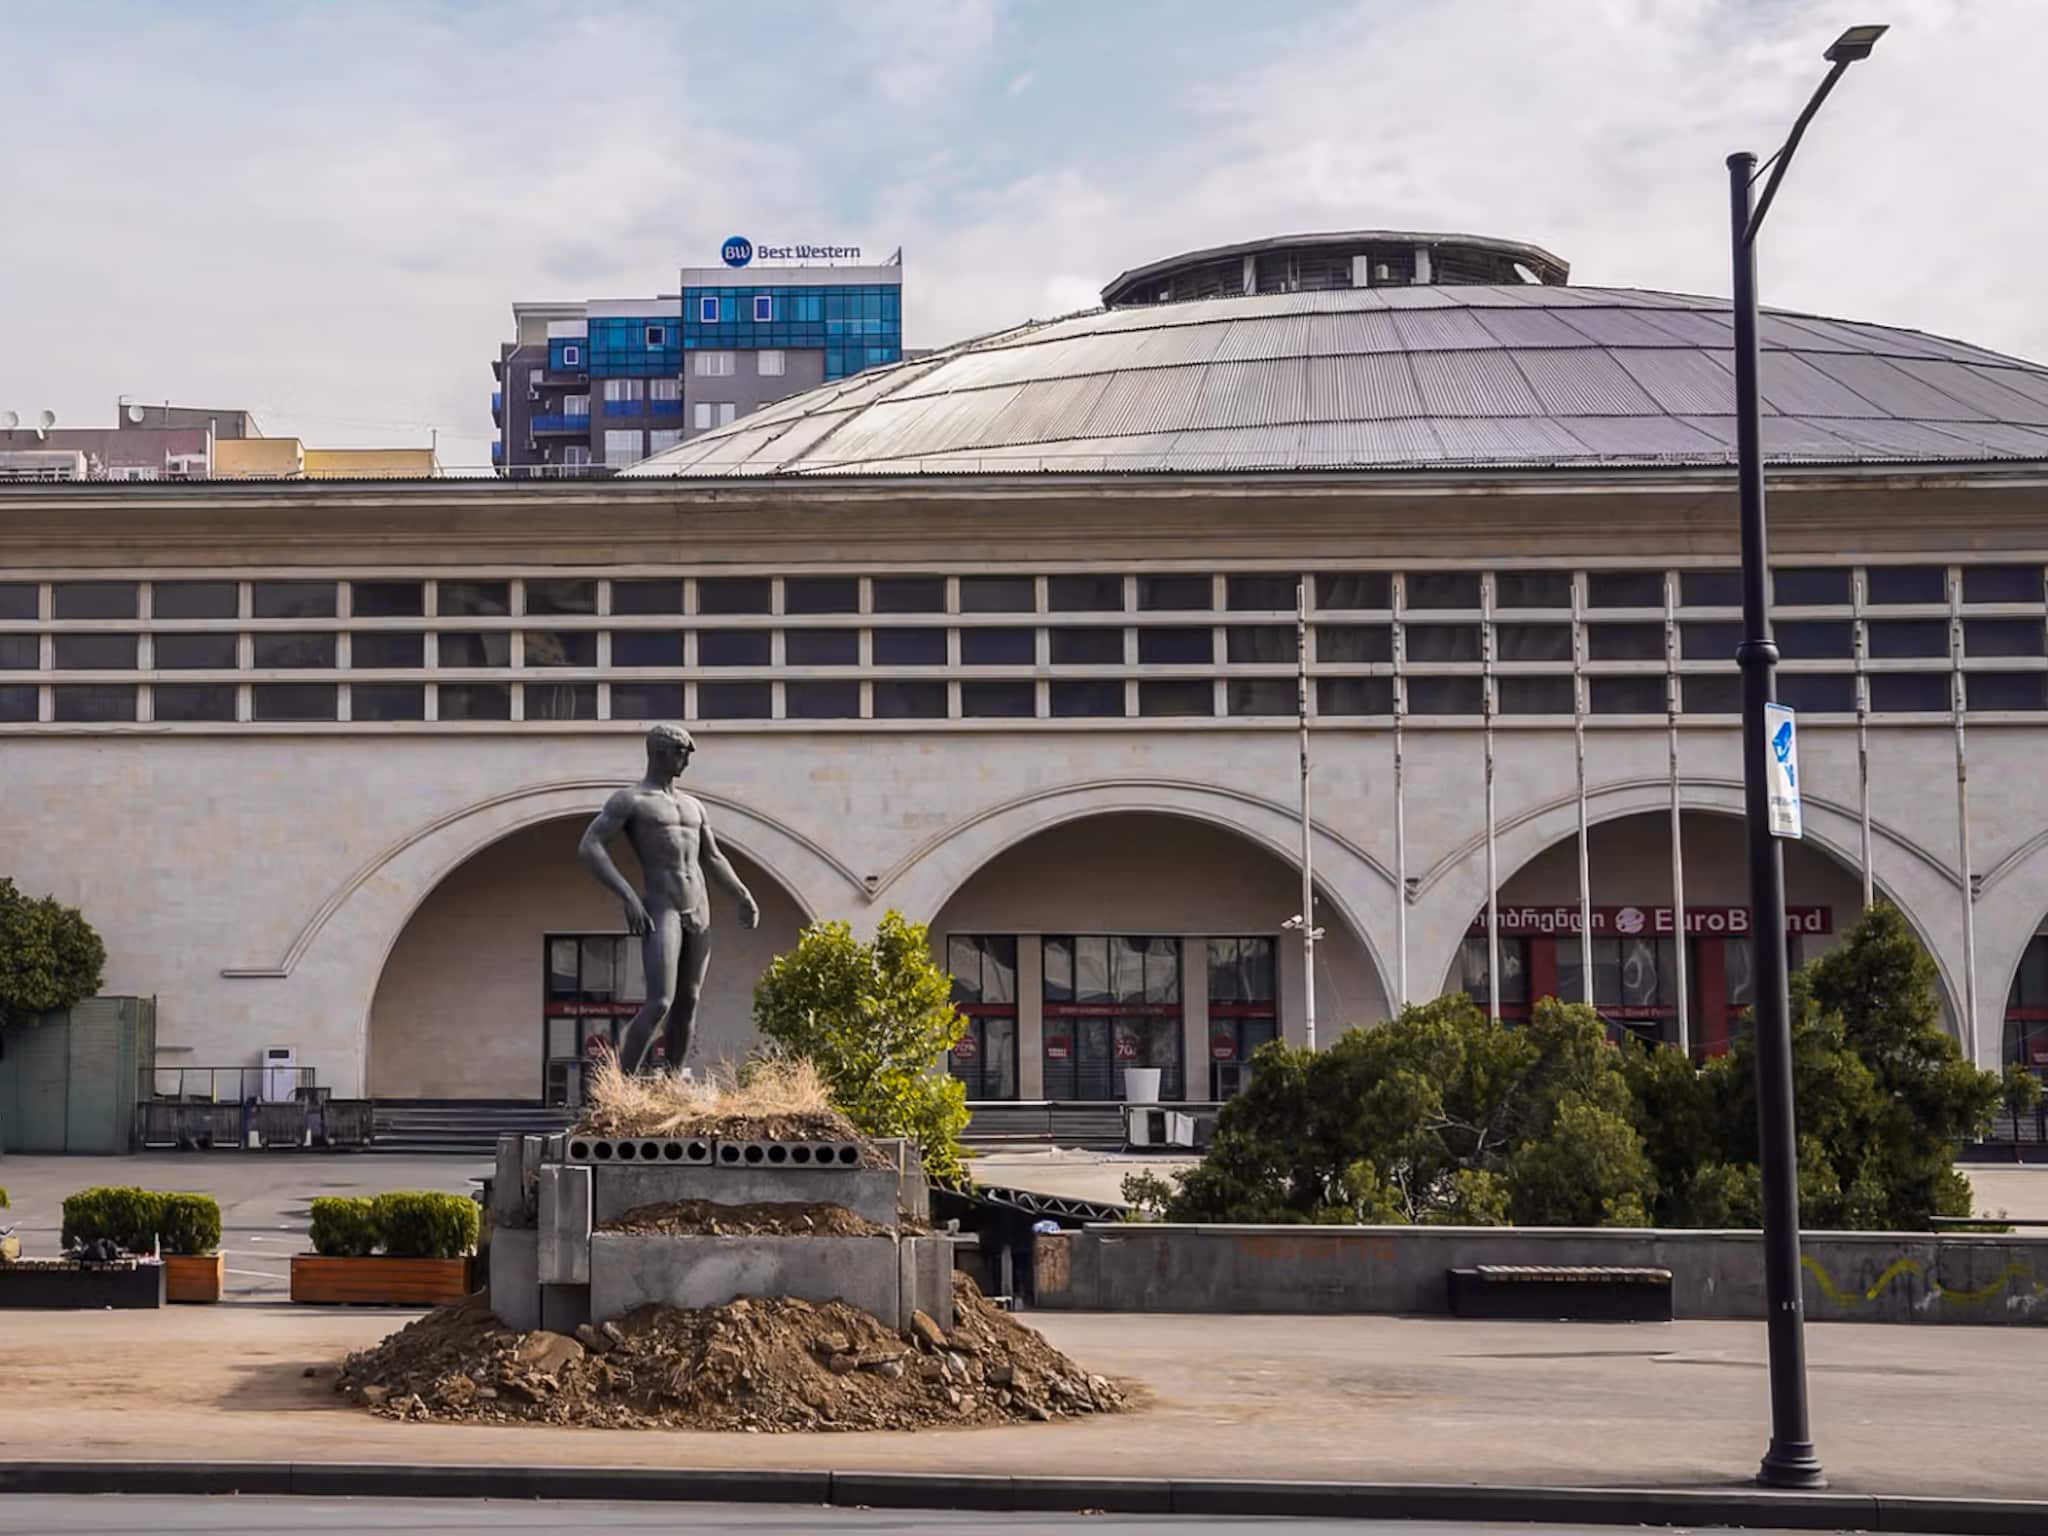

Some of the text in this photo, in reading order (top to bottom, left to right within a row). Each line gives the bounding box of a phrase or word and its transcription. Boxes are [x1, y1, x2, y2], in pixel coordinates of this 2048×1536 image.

[724, 245, 751, 260] BW
[757, 245, 861, 259] Best Western
[1655, 908, 1821, 931] EuroBnd
